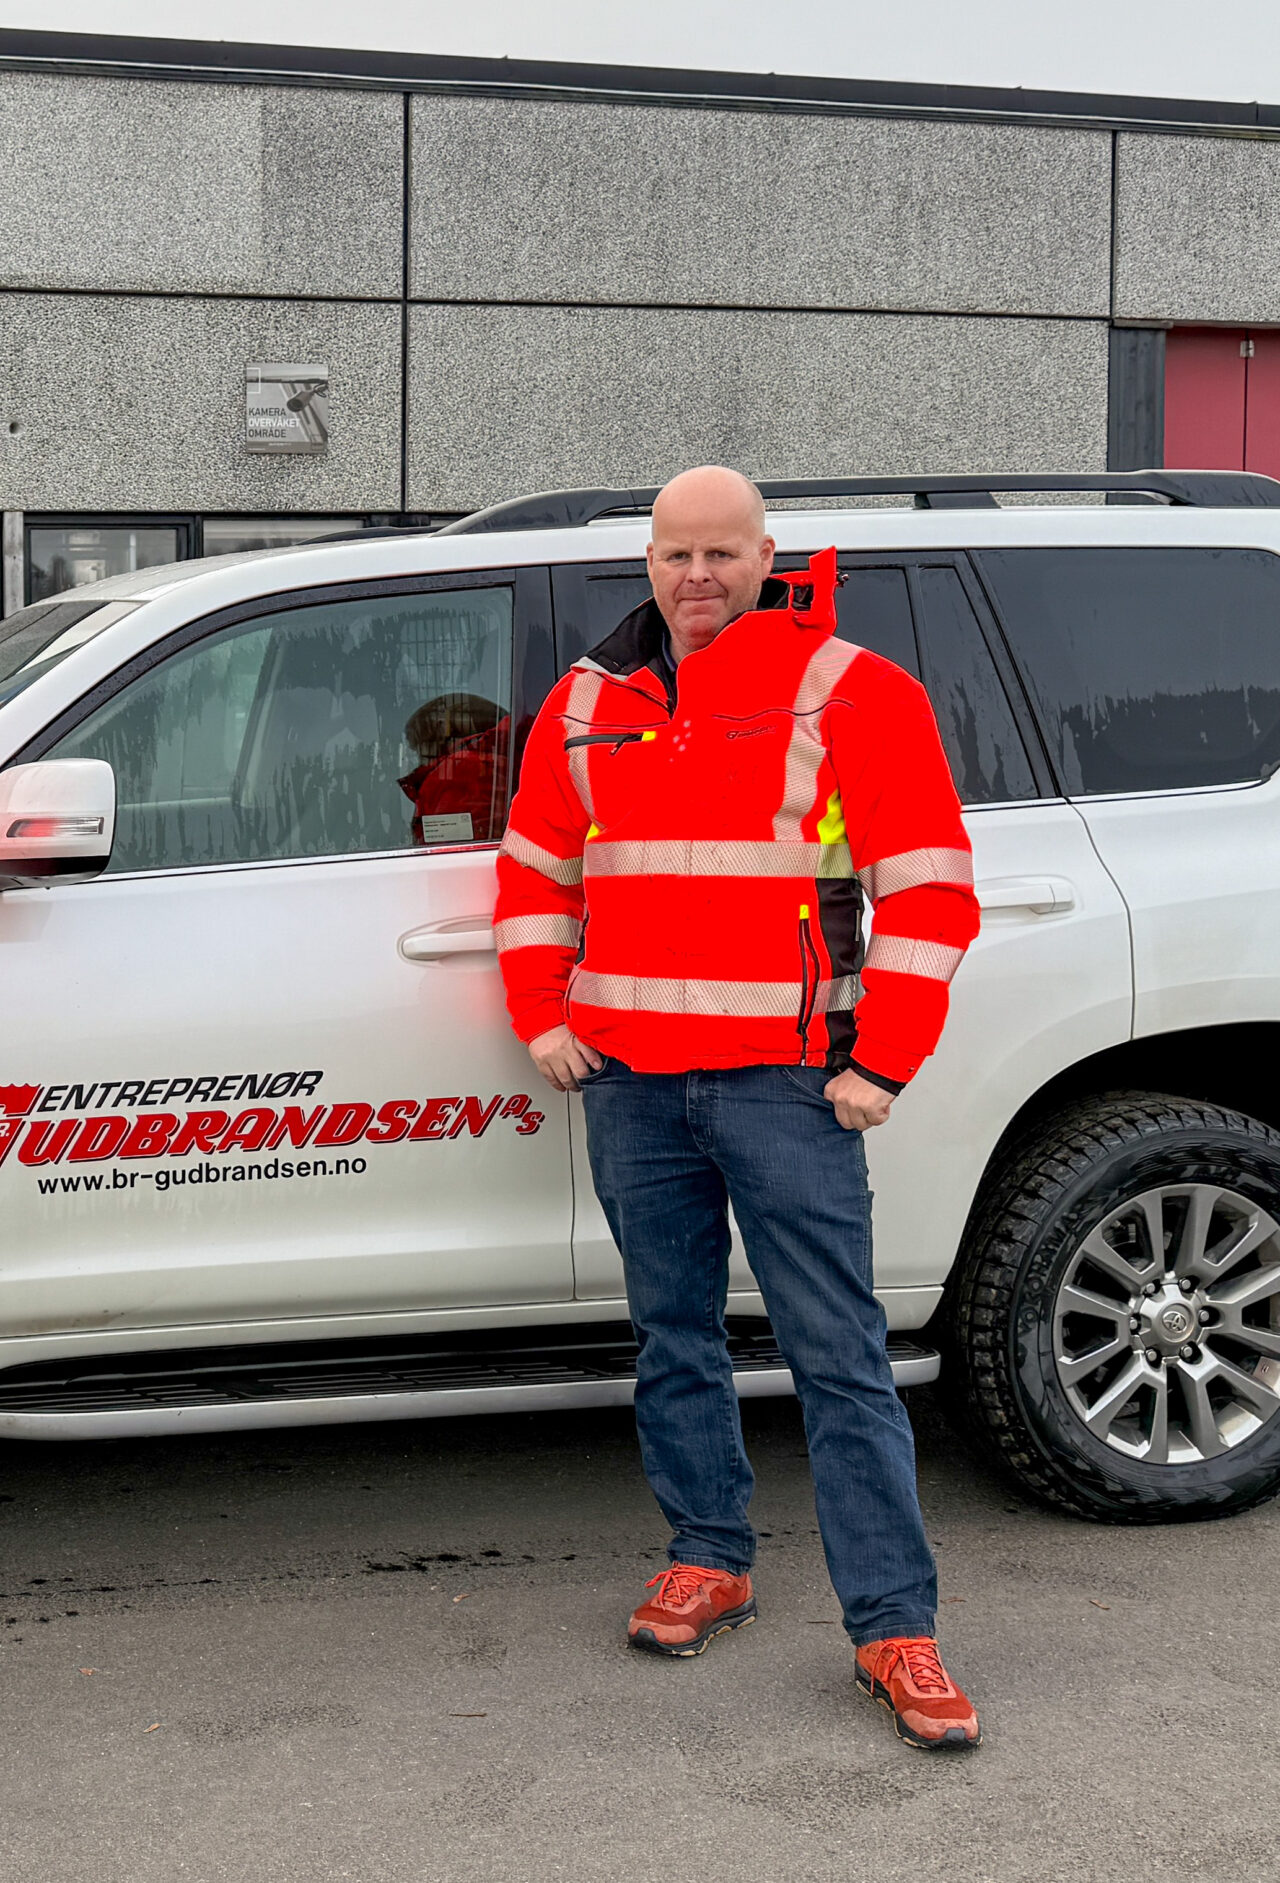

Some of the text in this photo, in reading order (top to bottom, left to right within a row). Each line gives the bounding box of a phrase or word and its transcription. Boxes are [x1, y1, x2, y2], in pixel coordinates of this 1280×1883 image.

[248, 407, 287, 416] KAMERA
[36, 1070, 324, 1113] ENTREPRENØR
[37, 1157, 368, 1196] www.br-gudbrandsen.no
